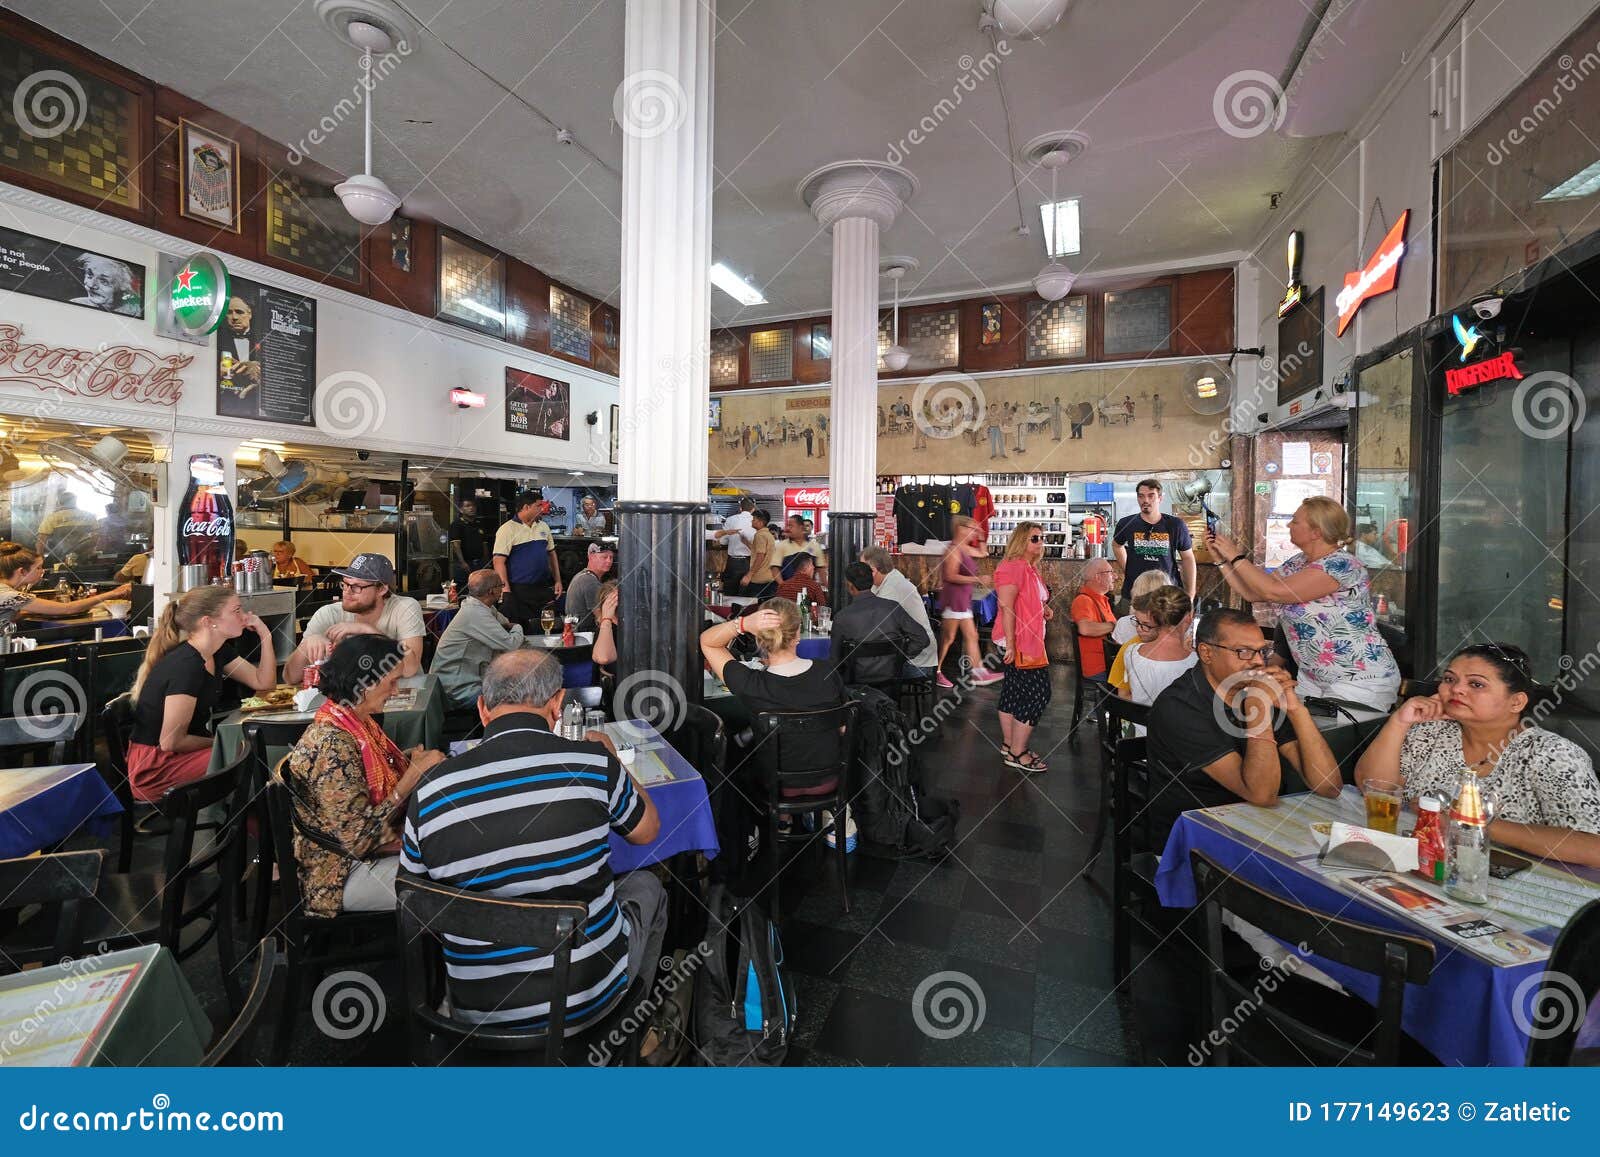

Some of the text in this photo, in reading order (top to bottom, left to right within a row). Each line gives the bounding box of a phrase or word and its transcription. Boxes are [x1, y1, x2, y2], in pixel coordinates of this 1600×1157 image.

[9, 249, 25, 260] not
[19, 260, 51, 273] people
[510, 414, 528, 424] BOB
